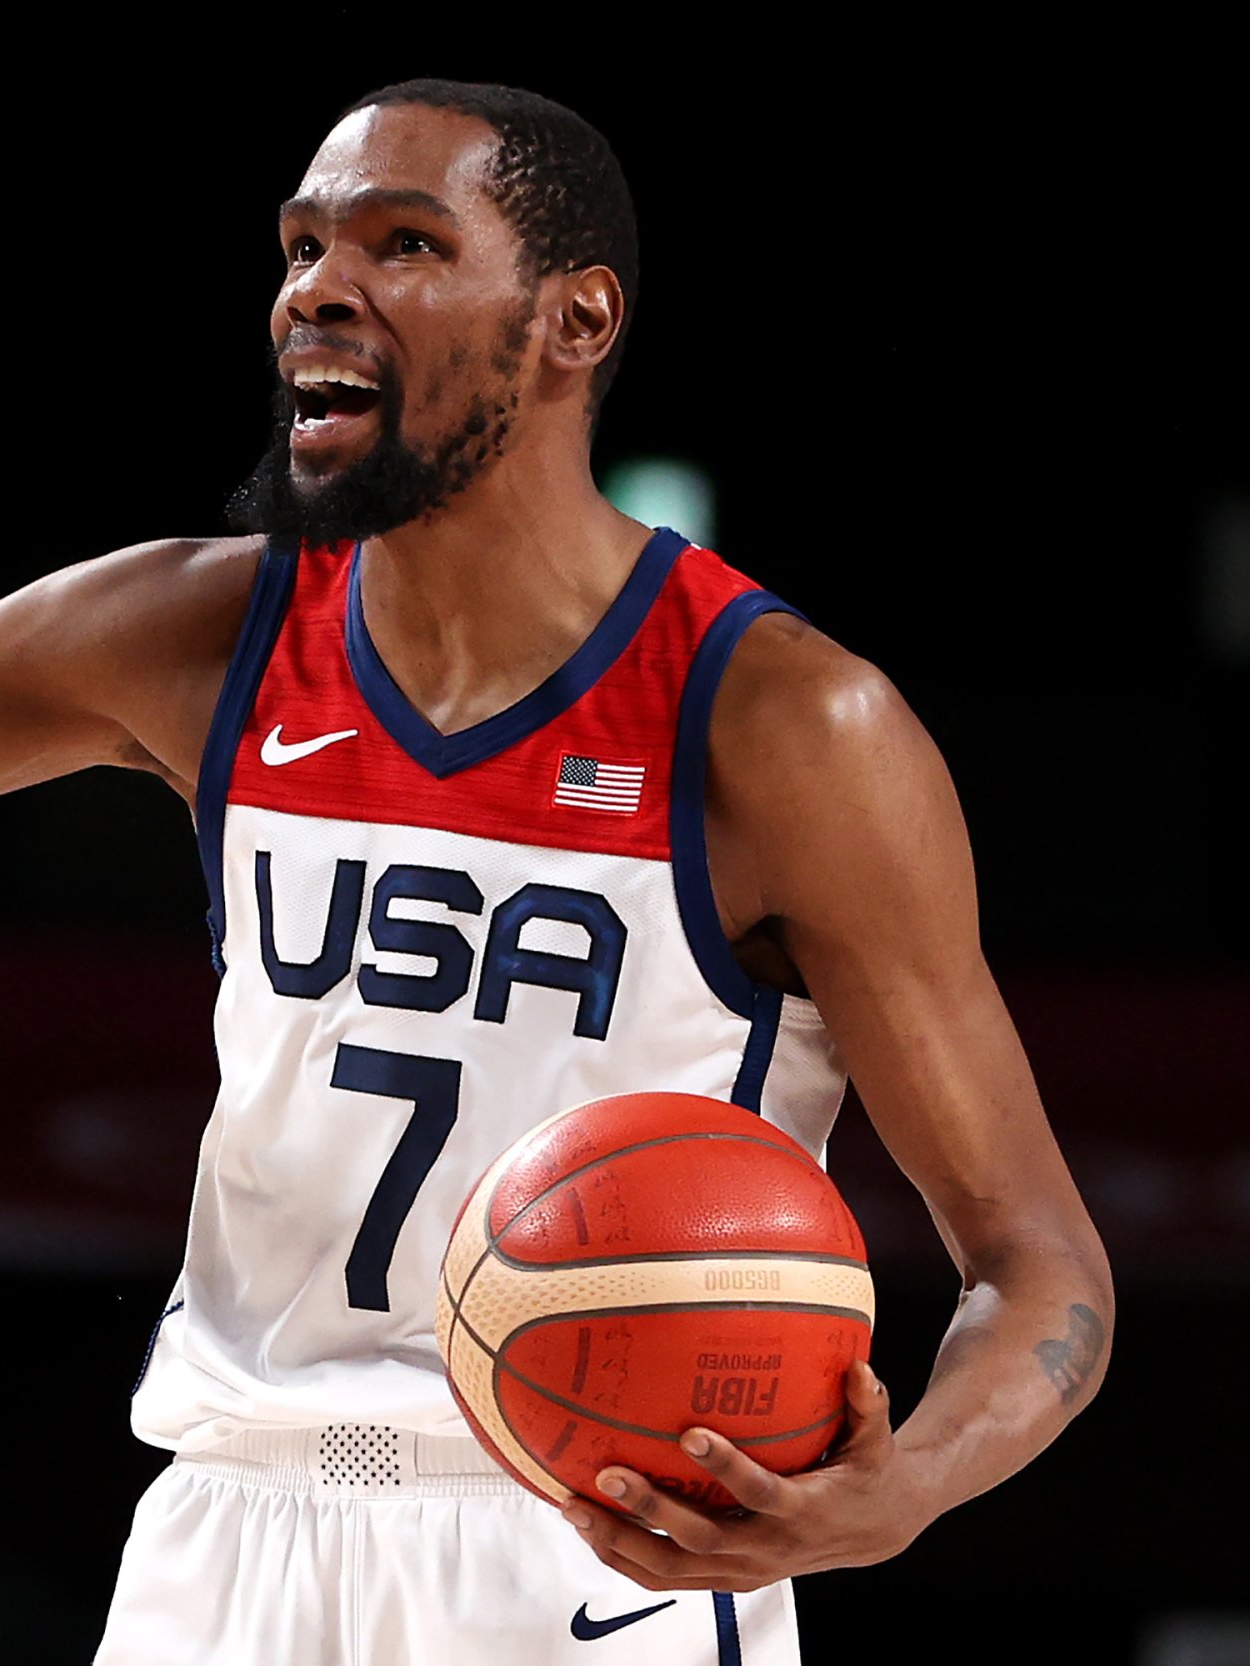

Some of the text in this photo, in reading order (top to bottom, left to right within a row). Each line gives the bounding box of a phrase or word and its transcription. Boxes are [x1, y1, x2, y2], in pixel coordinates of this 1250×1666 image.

[255, 850, 628, 1041] USA
[330, 1042, 463, 1312] 7
[704, 1269, 782, 1292] BG5000
[696, 1353, 783, 1371] APPROVED
[690, 1375, 779, 1417] FIBA
